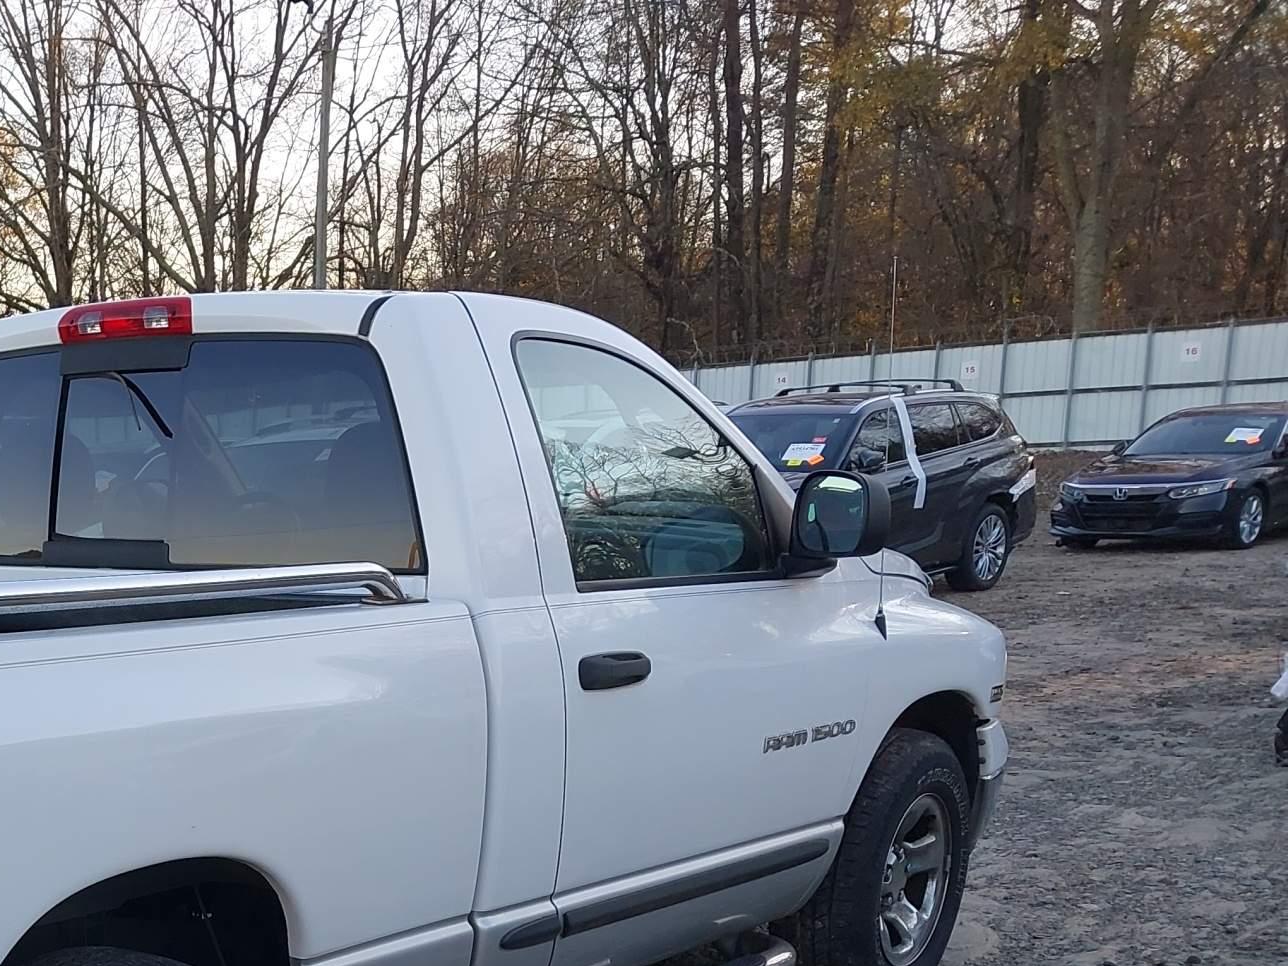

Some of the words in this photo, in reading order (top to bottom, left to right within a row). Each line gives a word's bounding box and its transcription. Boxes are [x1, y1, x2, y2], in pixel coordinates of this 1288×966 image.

[1185, 347, 1198, 356] 16
[965, 366, 976, 374] 15
[777, 376, 786, 384] 14
[763, 728, 809, 754] RAM
[811, 719, 857, 743] 1500
